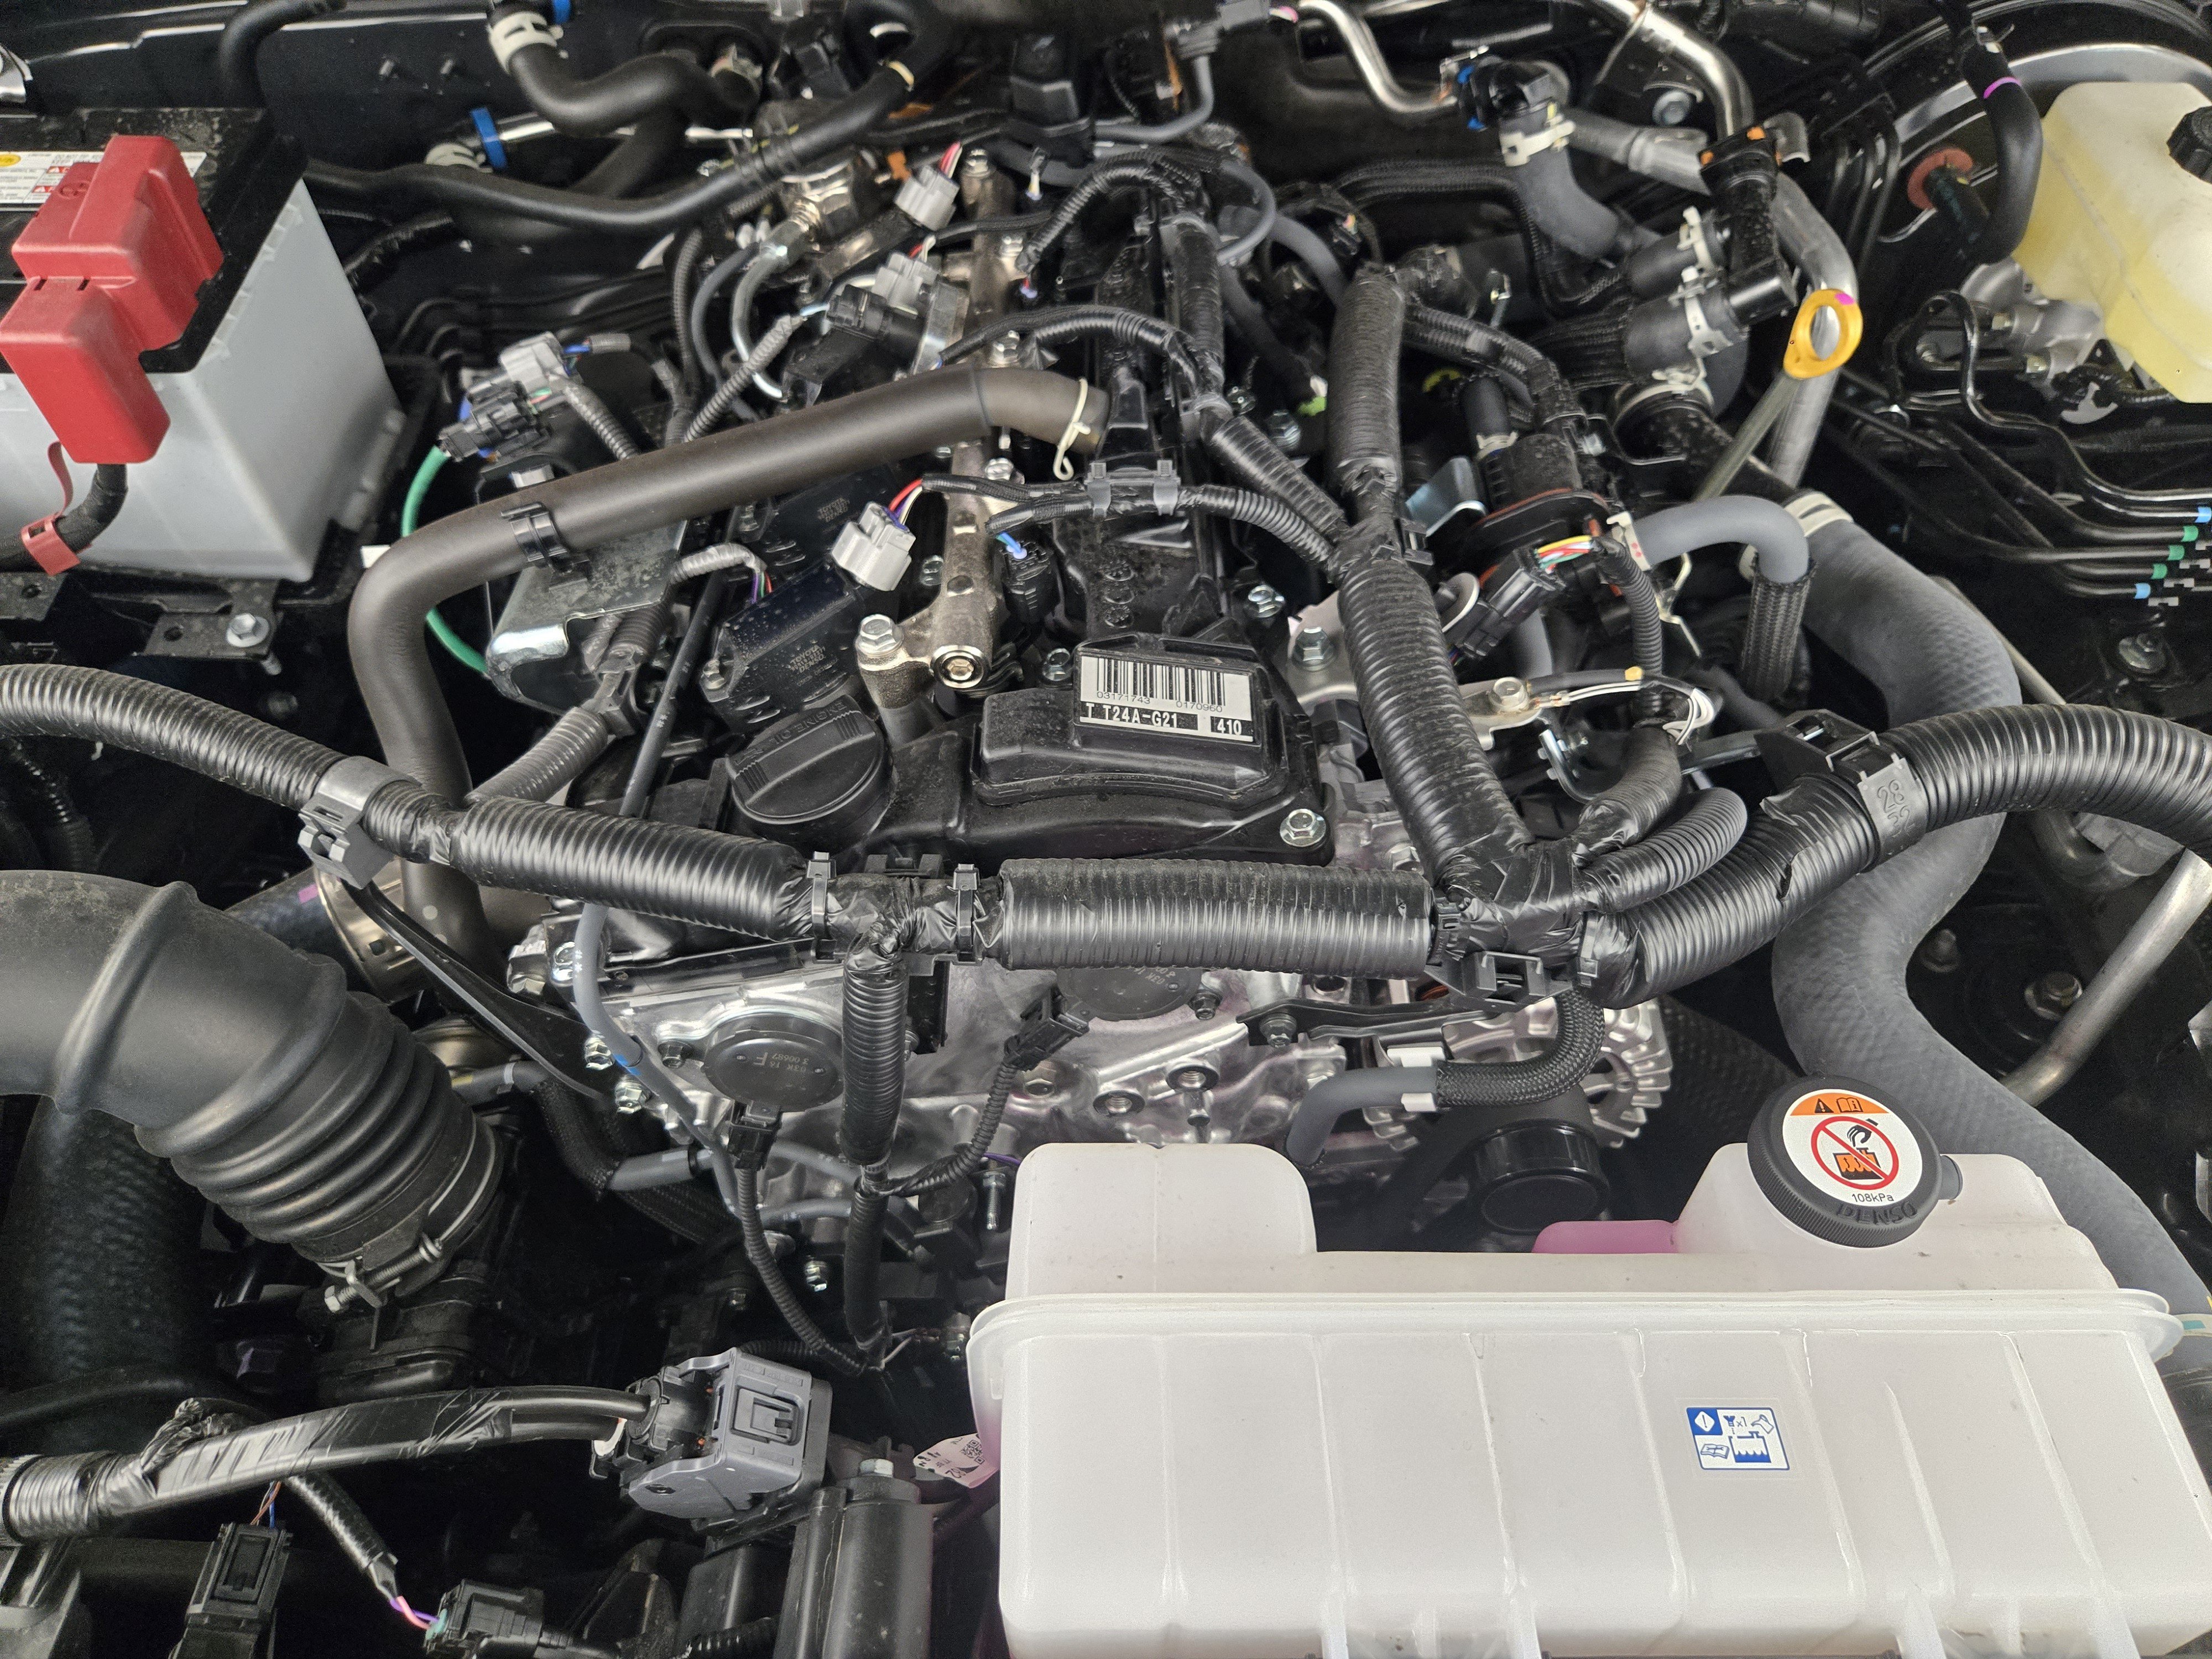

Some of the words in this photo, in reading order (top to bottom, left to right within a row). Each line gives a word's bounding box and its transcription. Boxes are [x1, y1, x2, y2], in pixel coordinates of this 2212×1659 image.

[789, 645, 822, 665] TOYOTA
[799, 653, 825, 673] DENSO
[1097, 691, 1150, 705] 03171743
[1176, 701, 1223, 713] 0170960
[794, 700, 847, 733] ENGINE
[1086, 702, 1094, 718] T
[1103, 705, 1177, 728] T24A-G21
[1217, 718, 1242, 735] 410
[769, 729, 792, 745] OIL
[1877, 779, 1906, 813] 28
[753, 1052, 768, 1066] F
[1851, 1193, 1894, 1202] 108kPa
[1836, 1202, 1917, 1225] DENSO
